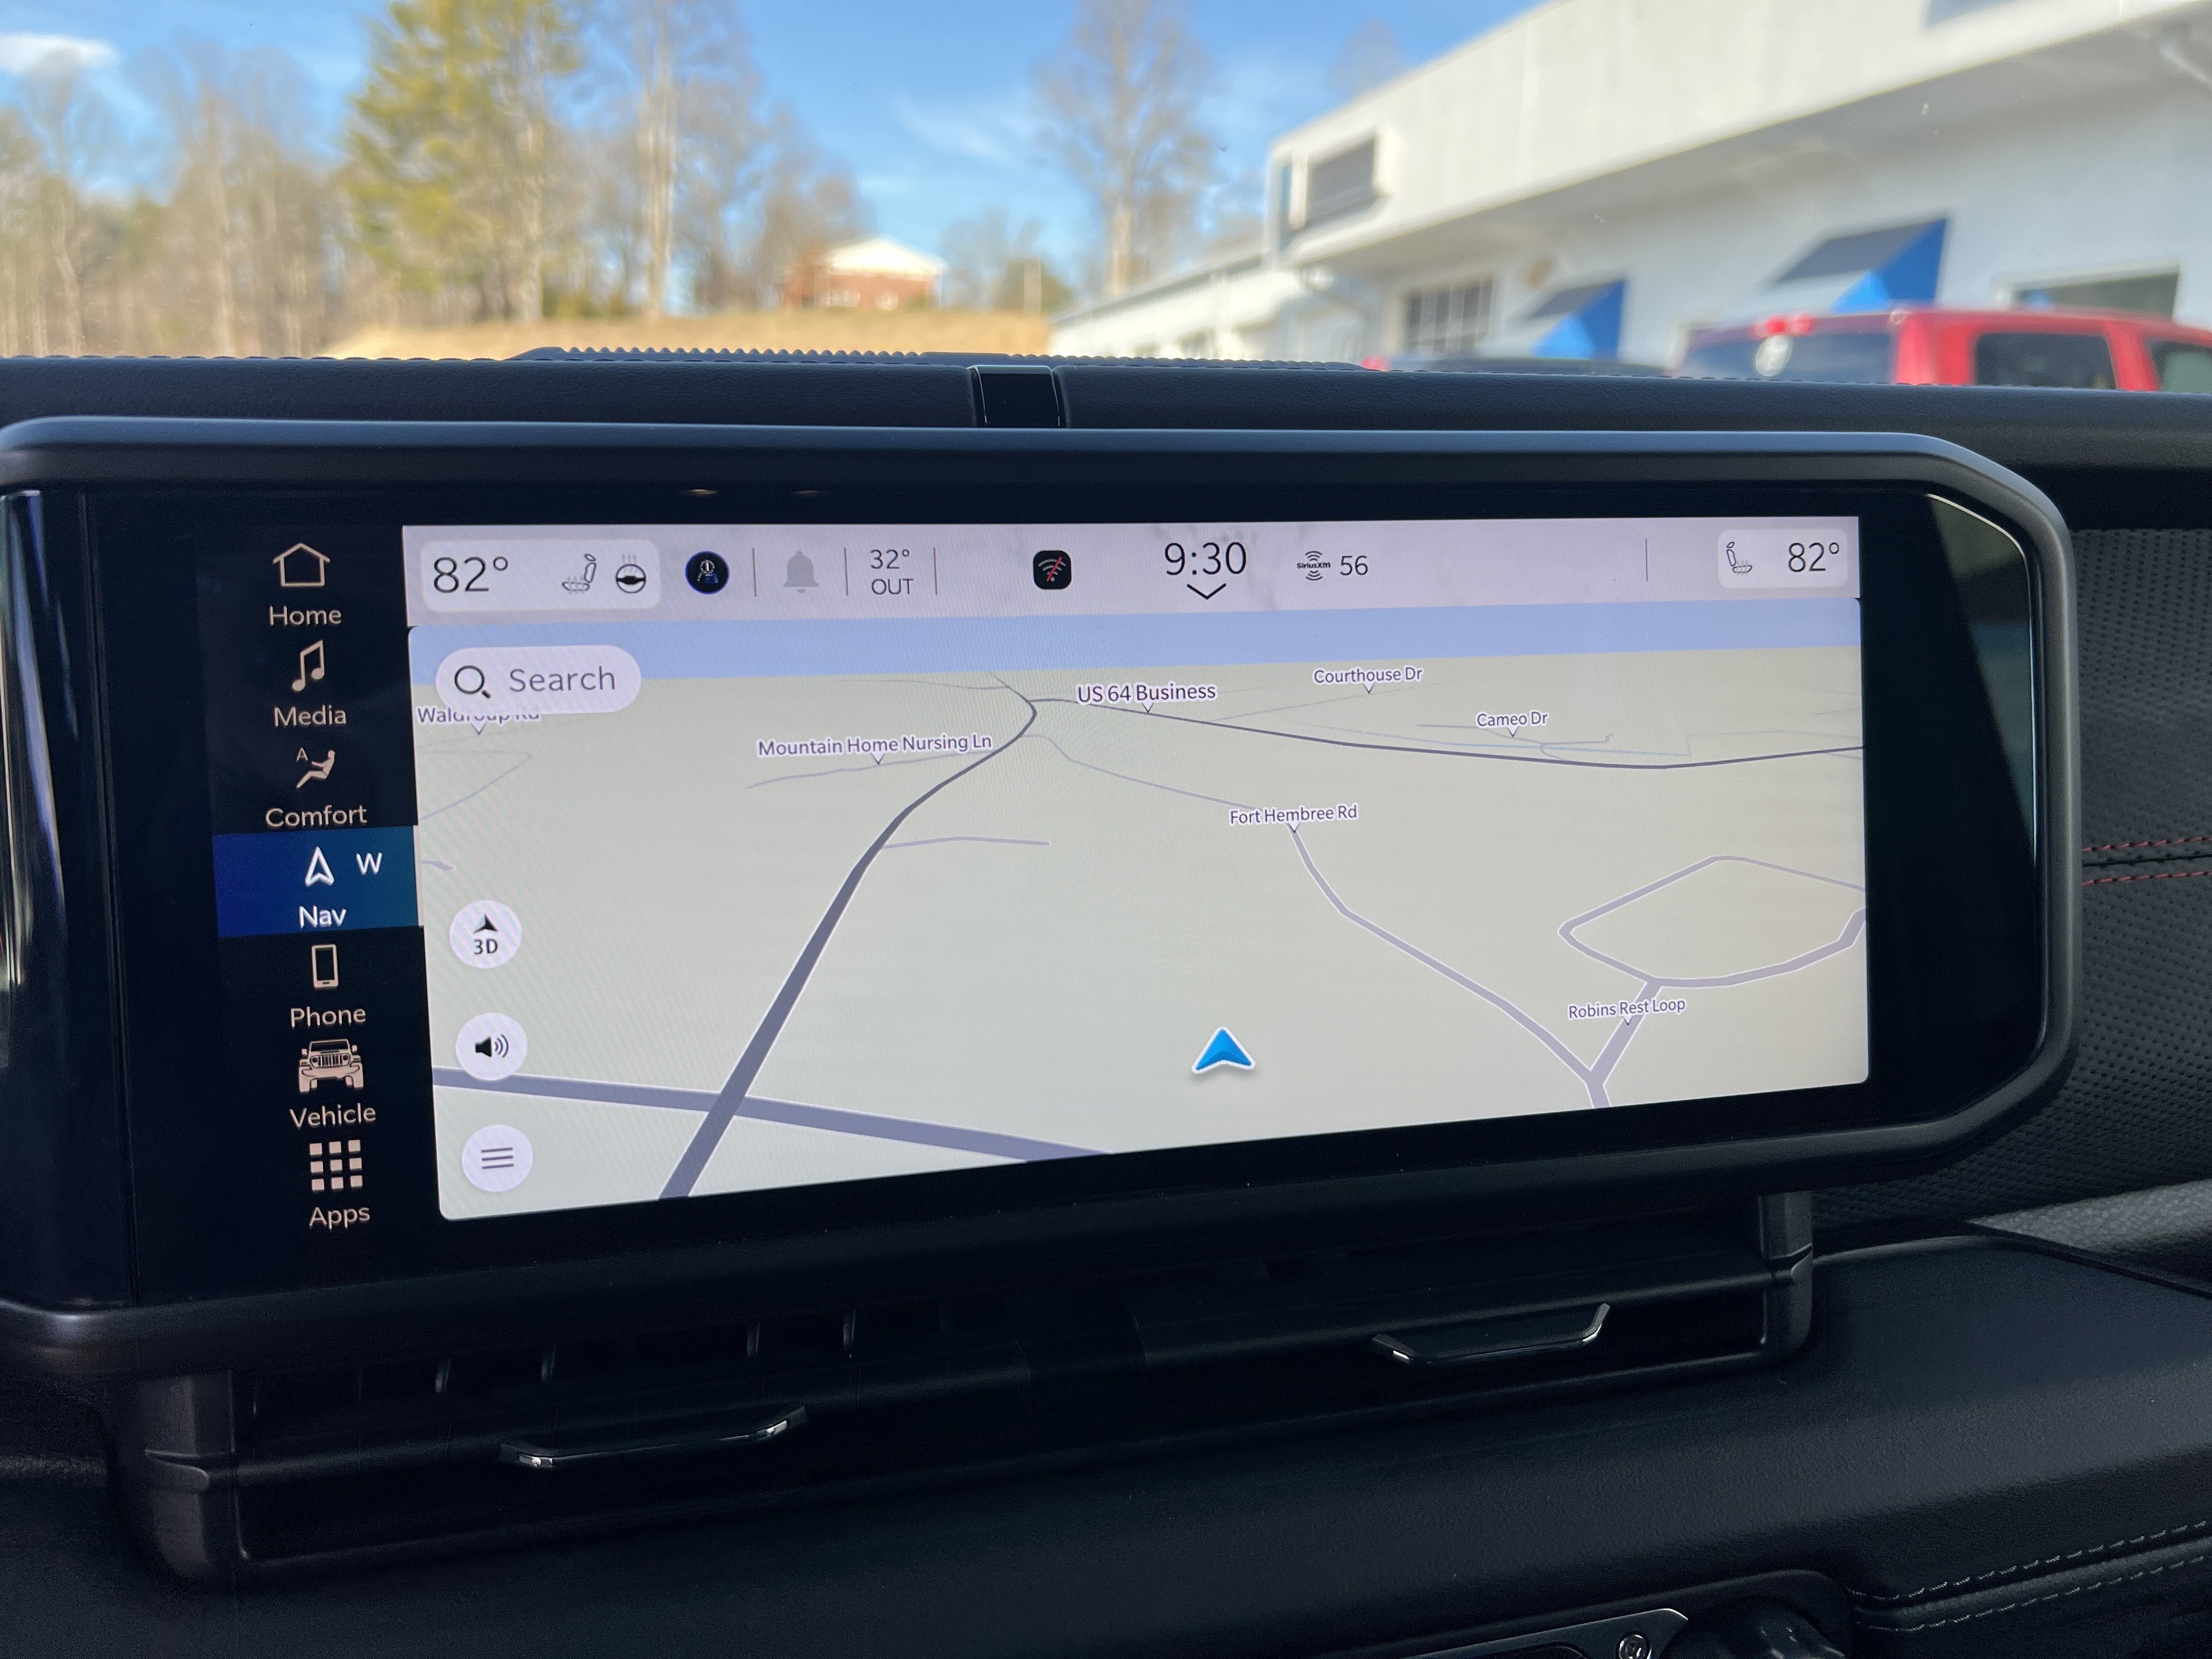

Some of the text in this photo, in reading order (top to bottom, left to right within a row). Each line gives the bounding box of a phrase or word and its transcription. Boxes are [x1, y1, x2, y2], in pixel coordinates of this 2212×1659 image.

[871, 549, 910, 569] 32°
[1165, 542, 1246, 575] 9:30
[1340, 555, 1368, 575] 56
[1788, 542, 1839, 572] 82°
[433, 556, 508, 593] 82°
[871, 578, 914, 595] OUT
[269, 606, 341, 625] Home
[510, 665, 615, 692] Search
[1314, 667, 1423, 683] Courthouse Dr
[1077, 683, 1216, 703] US 64 Business
[274, 704, 347, 726] Media
[1477, 712, 1548, 726] Cameo Dr
[759, 735, 991, 755] Mountain Home Nursing Ln
[266, 805, 368, 827] Comfort
[1231, 804, 1357, 824] Fort Hembree Rd
[356, 853, 383, 874] W
[299, 905, 347, 928] Nav
[475, 939, 498, 955] 3D
[291, 1006, 366, 1028] Phone
[1569, 1000, 1685, 1019] Robins Rest Loop
[290, 1103, 376, 1127] Vehicle
[309, 1207, 370, 1229] Apps
